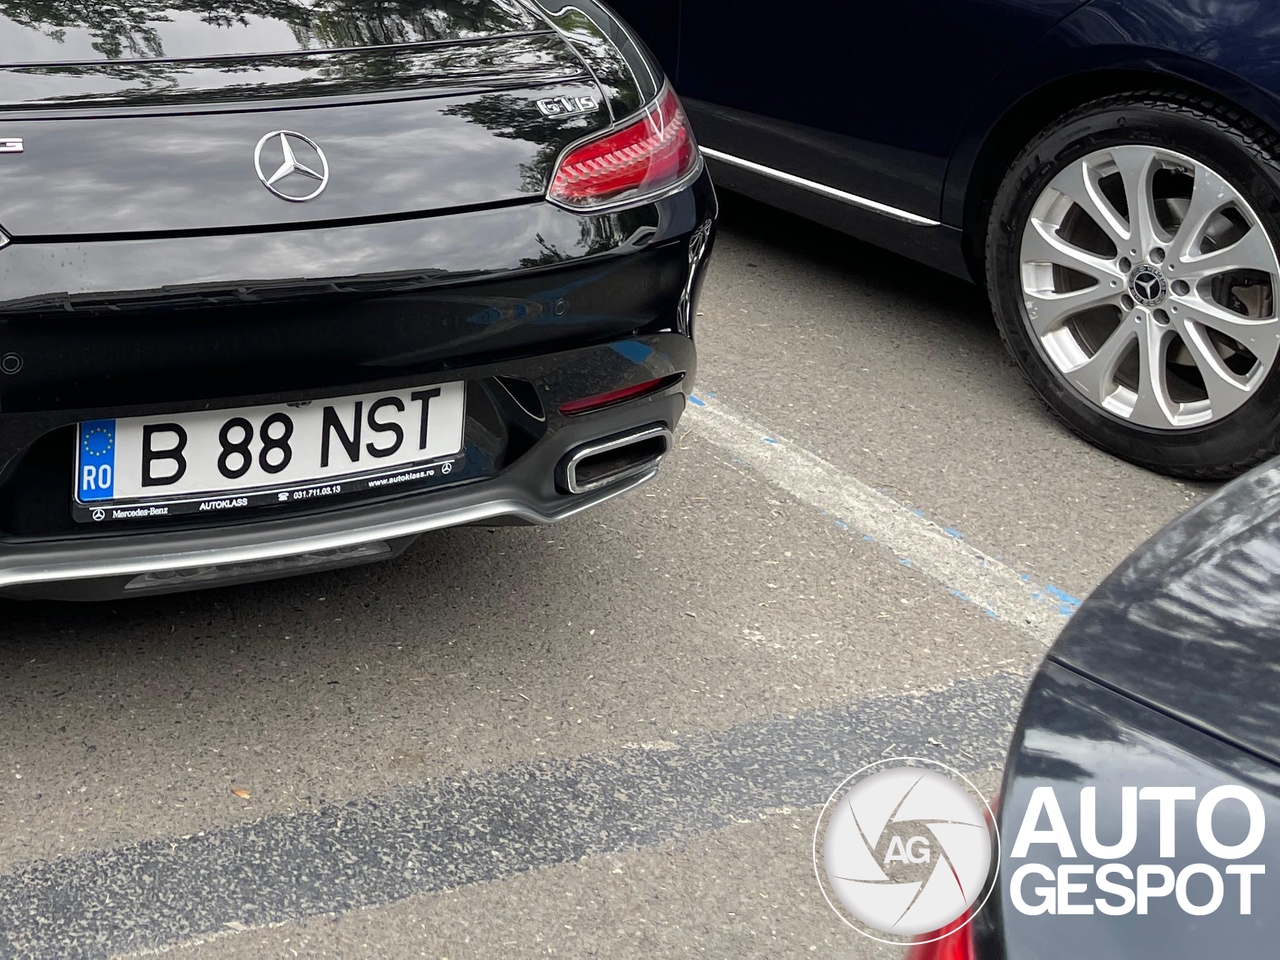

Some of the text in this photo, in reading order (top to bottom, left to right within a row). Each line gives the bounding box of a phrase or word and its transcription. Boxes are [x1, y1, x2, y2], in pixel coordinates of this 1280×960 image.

[141, 387, 441, 487] B 88 NST
[83, 464, 112, 490] RO
[112, 469, 435, 518] Mercedes-Benz AUTOKLASS 031.711.03.13 www.autoklass.ro
